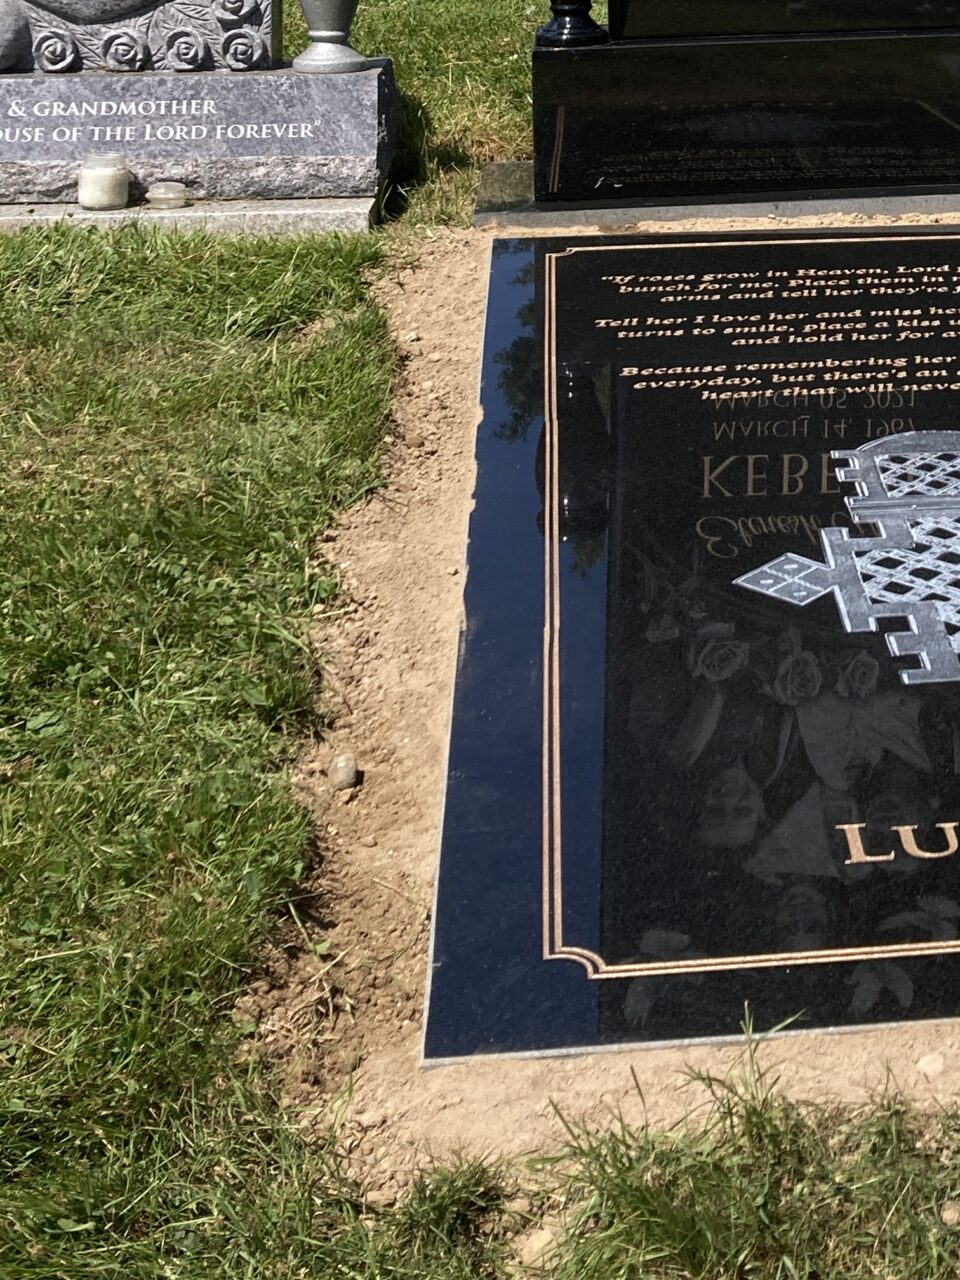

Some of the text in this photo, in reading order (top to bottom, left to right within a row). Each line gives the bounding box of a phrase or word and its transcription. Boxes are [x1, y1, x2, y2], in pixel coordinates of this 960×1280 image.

[7, 98, 218, 117] & GRANDMOTHER
[0, 126, 46, 143] USE
[52, 126, 84, 142] OF
[88, 125, 136, 142] THE
[144, 123, 208, 141] LORD
[639, 273, 696, 283] roses
[700, 271, 761, 283] grow
[766, 269, 789, 278] in
[796, 267, 889, 278] Heaven,
[896, 264, 951, 274] Lord
[619, 282, 691, 294] bunch
[694, 281, 733, 293] for
[739, 281, 780, 290] me.
[788, 277, 851, 288] Place
[857, 275, 915, 286] them
[922, 274, 945, 283] in
[660, 293, 722, 303] arms
[728, 290, 775, 301] and
[781, 288, 818, 298] tell
[824, 287, 864, 297] her
[870, 285, 950, 296] they're
[594, 317, 639, 328] Tell
[645, 316, 688, 326] her
[693, 315, 706, 324] I
[712, 313, 762, 323] love
[768, 312, 809, 321] her
[815, 309, 863, 319] and
[870, 308, 922, 317] miss
[617, 328, 684, 339] turns
[692, 326, 717, 336] to
[723, 323, 795, 335] smile,
[801, 321, 867, 334] place
[875, 320, 890, 329] a
[896, 318, 941, 328] kiss
[731, 335, 781, 346] and
[787, 333, 844, 344] hold
[850, 331, 892, 342] her
[895, 330, 935, 342] for
[619, 364, 728, 377] Because
[734, 357, 908, 372] remembering
[914, 355, 957, 365] her
[633, 375, 762, 390] everyday,
[771, 373, 817, 384] but
[822, 368, 908, 382] there's
[915, 368, 948, 378] an
[701, 388, 775, 401] heart
[782, 385, 838, 397] that
[844, 382, 895, 394] will
